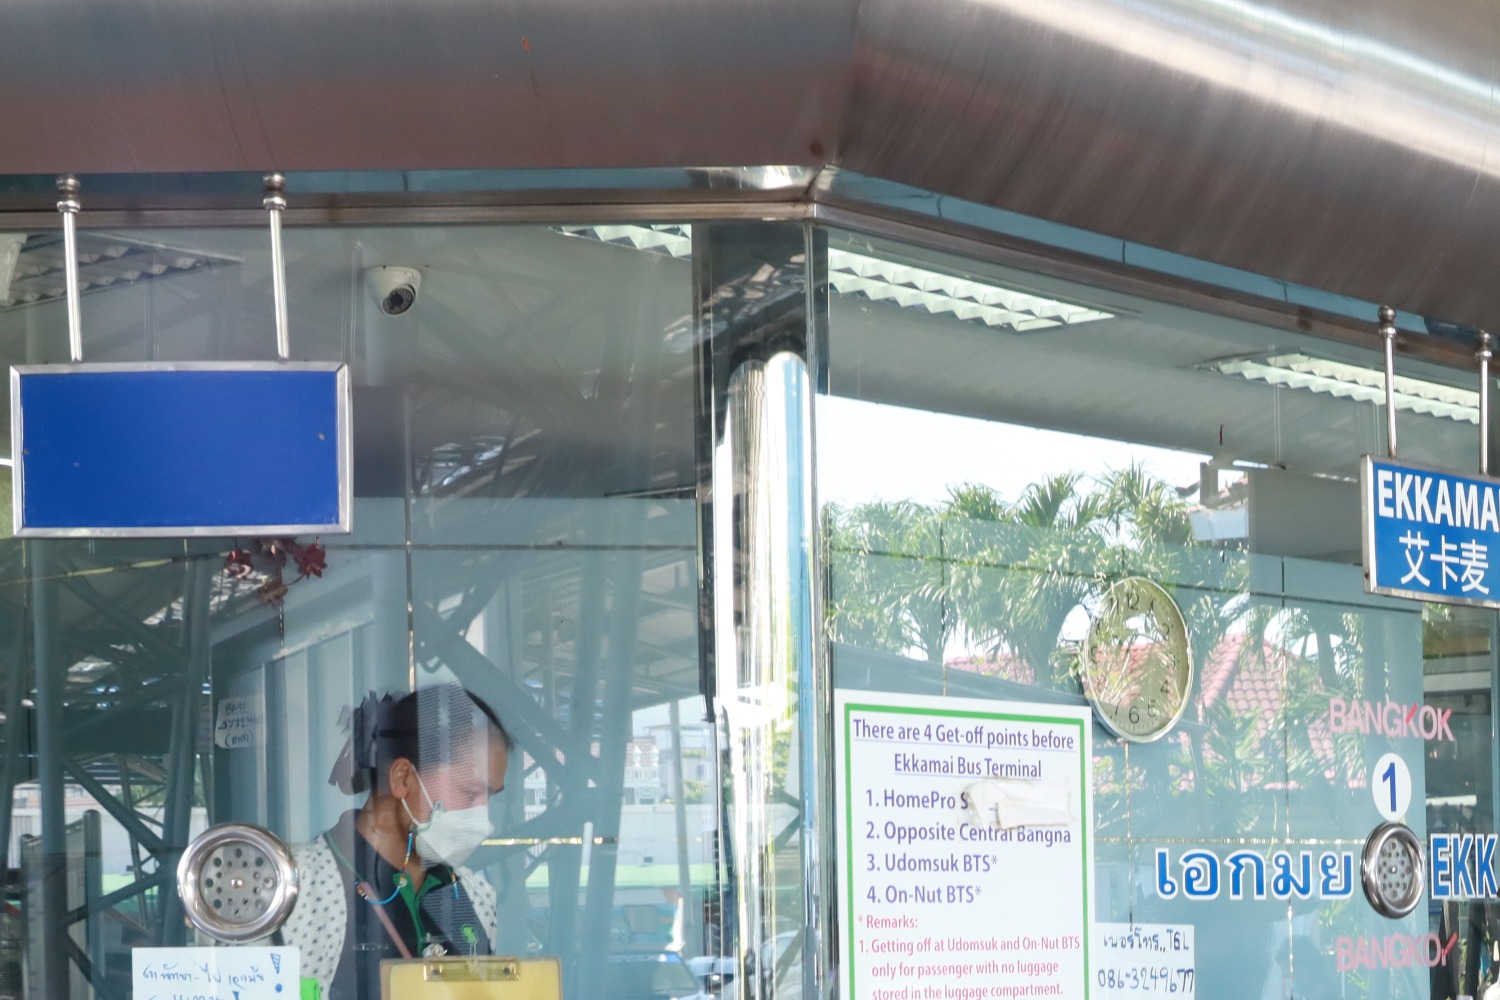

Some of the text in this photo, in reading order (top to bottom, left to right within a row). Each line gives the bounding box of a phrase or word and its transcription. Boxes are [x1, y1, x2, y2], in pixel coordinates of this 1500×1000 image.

[1399, 529, 1490, 595] 艾卡麦
[1128, 706, 1140, 724] 6
[1329, 697, 1455, 742] BANGKOK
[853, 718, 1074, 749] There are 4 Get-off points before
[894, 752, 1042, 778] Ekkamai Bus Terminal
[1382, 762, 1397, 812] 1
[866, 789, 879, 807] 1.
[884, 789, 956, 810] HomePro
[866, 820, 1072, 848] 2. Opposite Central Bangna
[867, 853, 880, 871] 3.
[885, 852, 959, 872] Udomsuk
[867, 885, 881, 903] 4.
[885, 885, 942, 904] On-Nut
[866, 914, 917, 929] Remarks:
[859, 936, 1080, 956] 1. Getting off at Udomsuk and On-Nut BTS
[872, 960, 1058, 980] only for passenger with no luggage
[1098, 966, 1194, 993] 086-3249677
[873, 986, 908, 1000] stored
[911, 986, 921, 1000] in
[924, 985, 942, 999] the
[991, 983, 1063, 1000] compartment.
